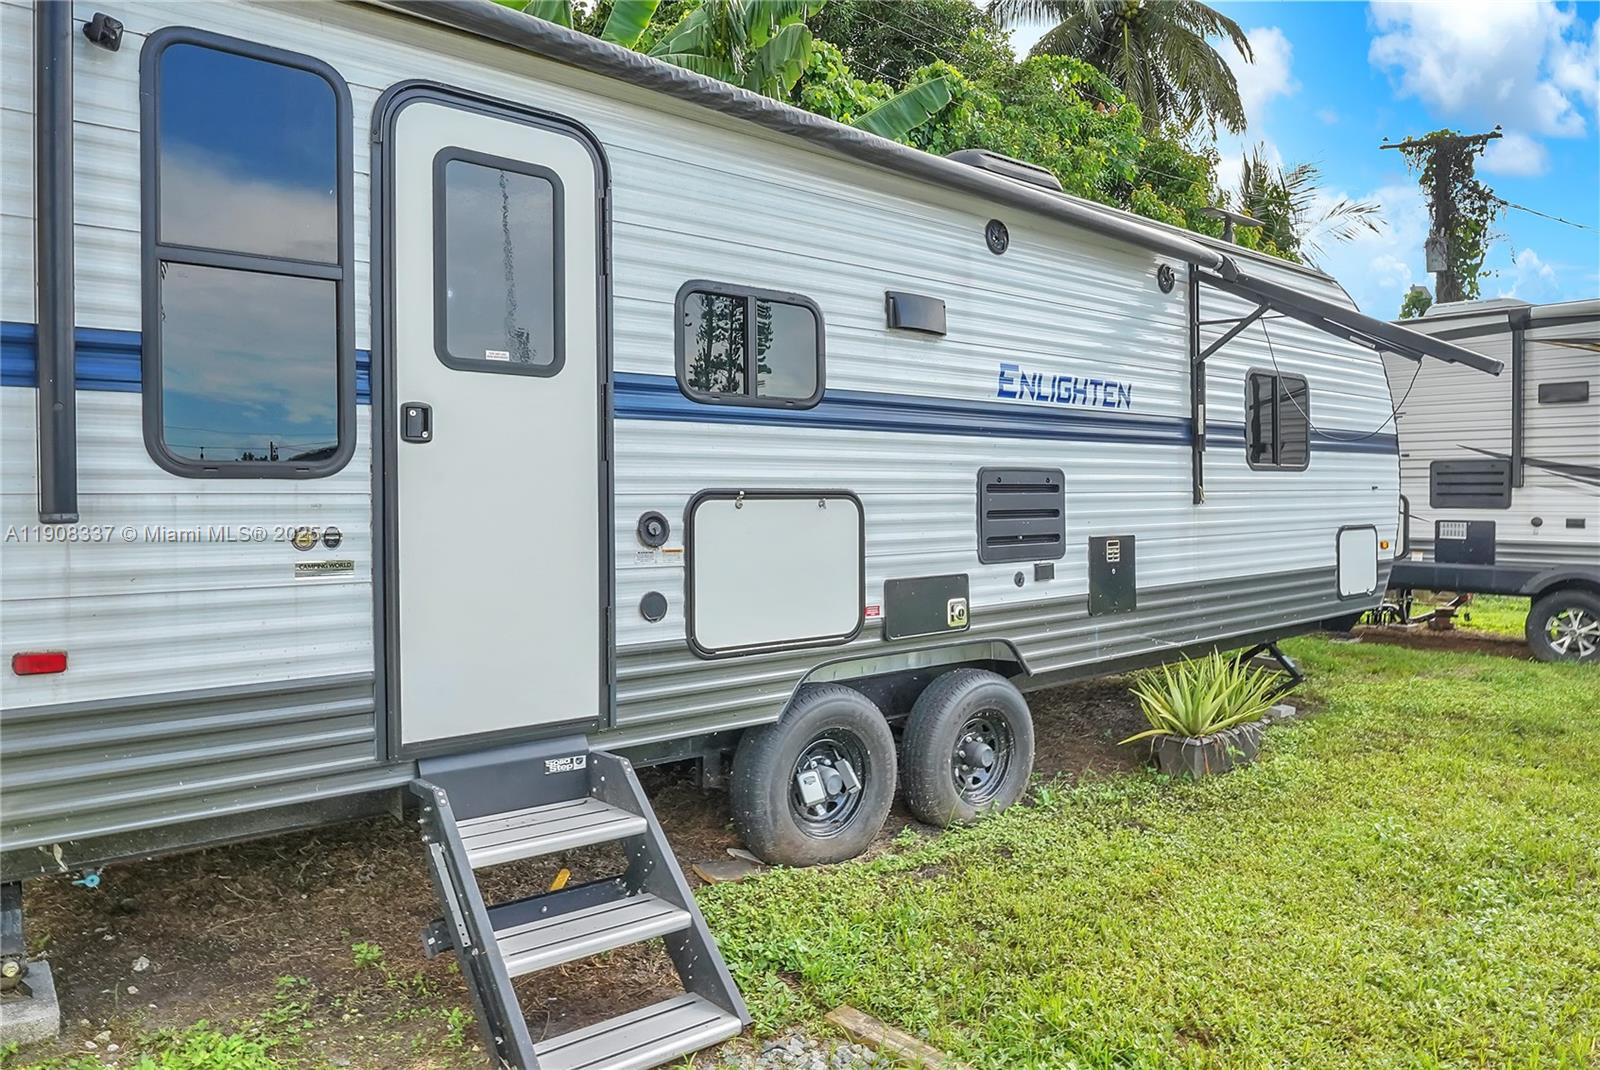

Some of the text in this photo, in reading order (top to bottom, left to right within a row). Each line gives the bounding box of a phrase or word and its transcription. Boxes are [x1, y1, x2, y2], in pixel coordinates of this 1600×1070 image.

[997, 363, 1132, 409] ENLIGHTEN
[298, 562, 352, 571] CAMPING WORLD
